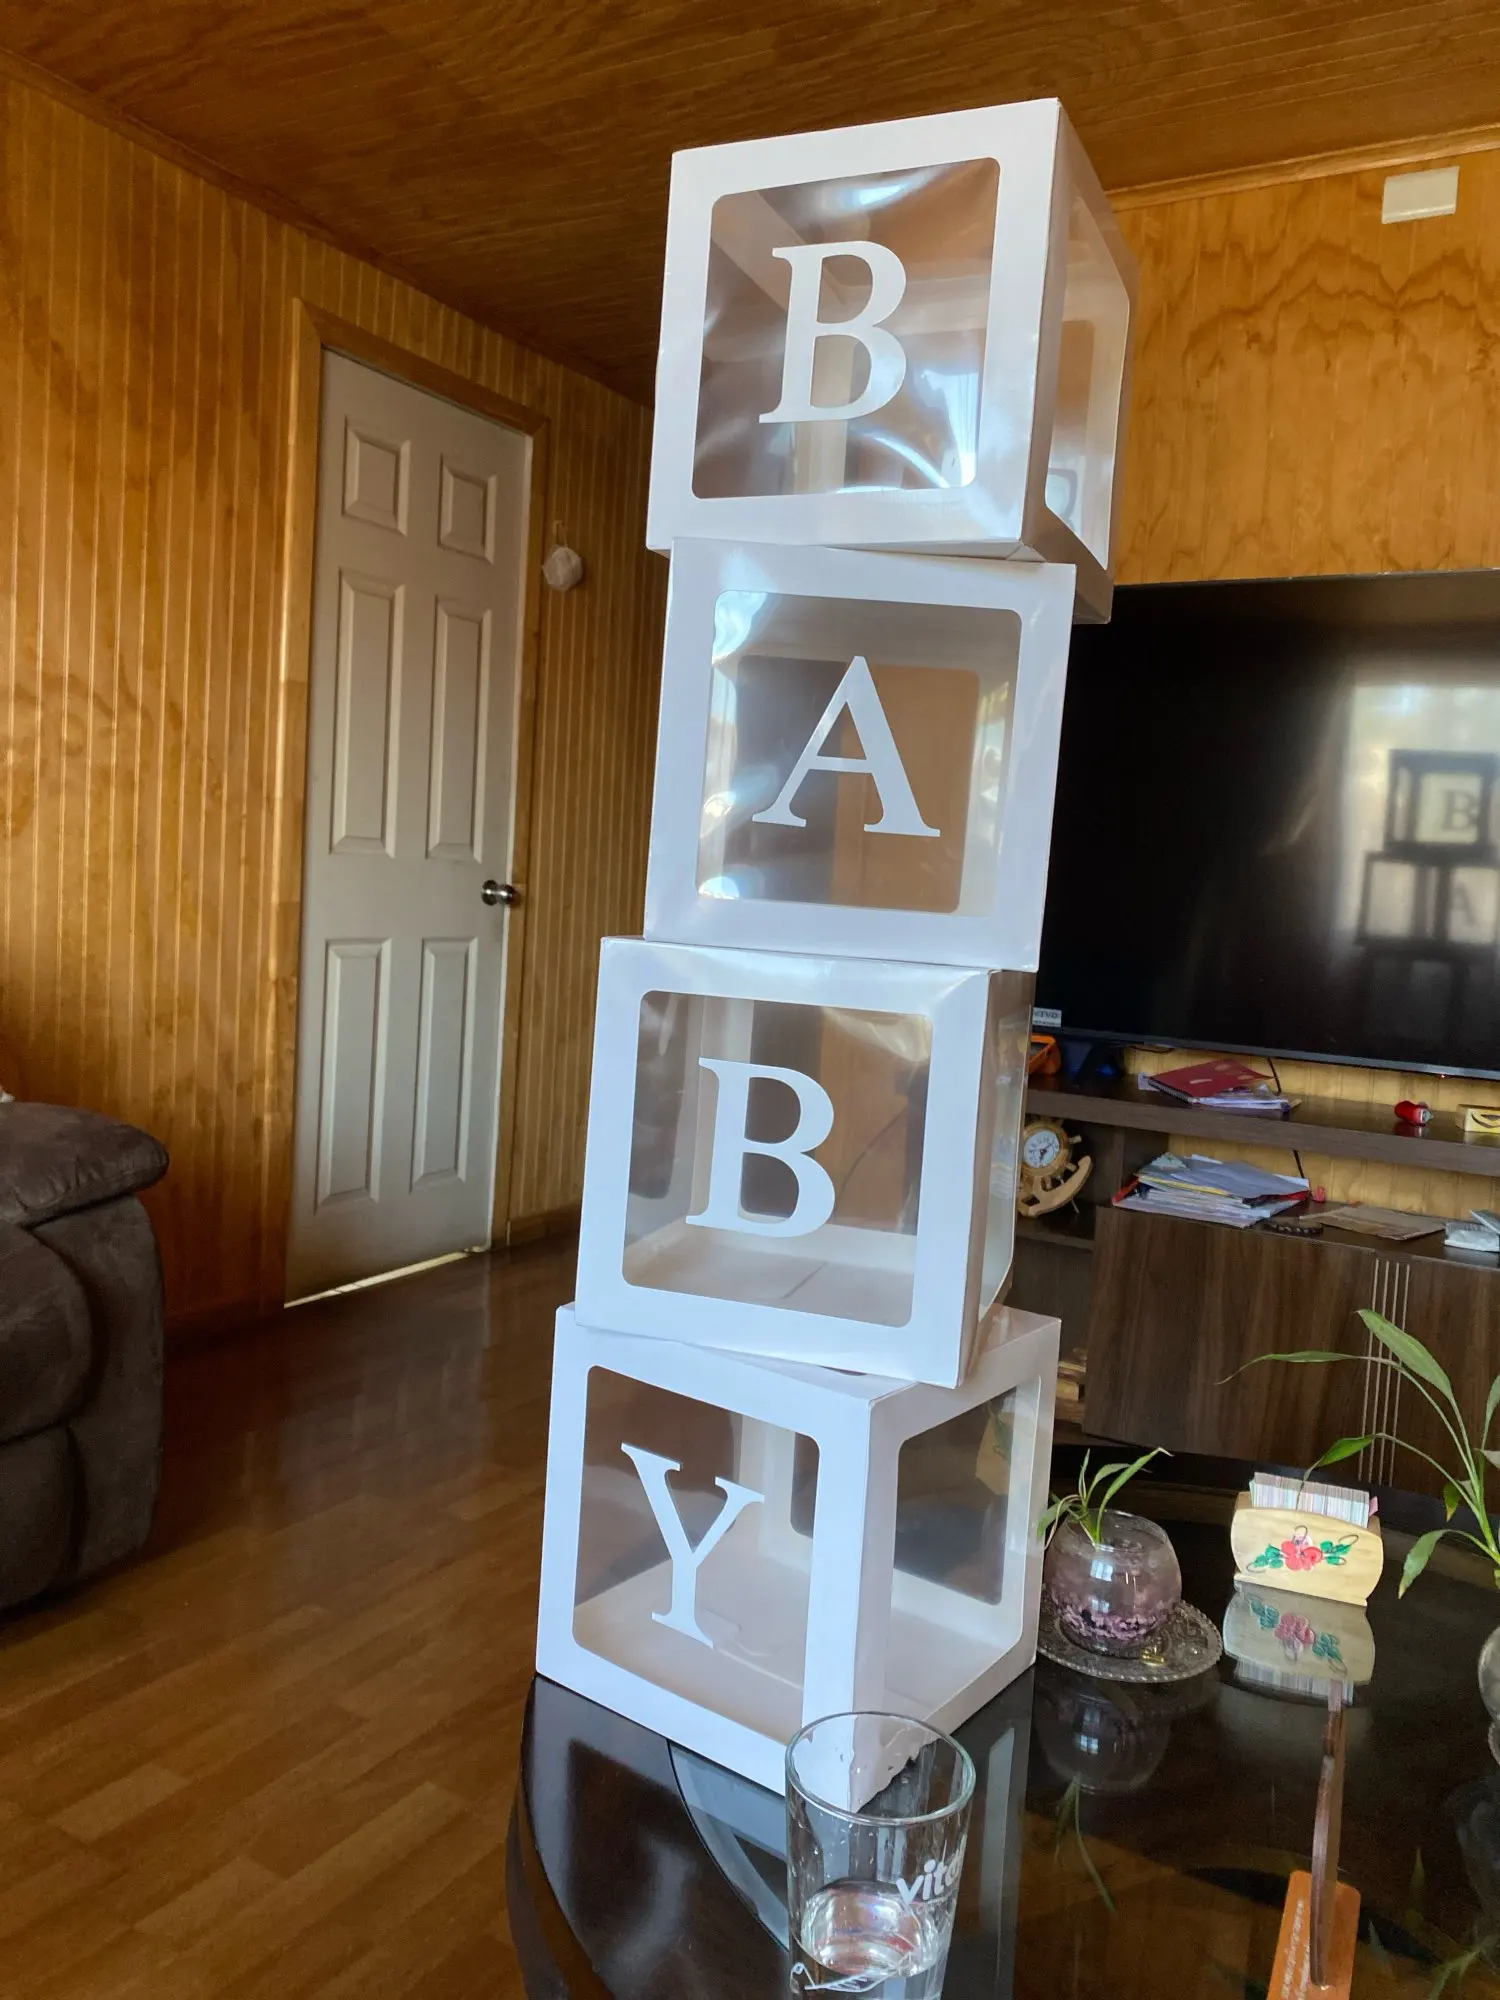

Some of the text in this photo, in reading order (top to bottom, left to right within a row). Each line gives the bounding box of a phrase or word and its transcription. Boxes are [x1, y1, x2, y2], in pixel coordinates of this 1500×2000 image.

[759, 240, 907, 424] B
[752, 655, 941, 838] A
[685, 1057, 836, 1238] B
[620, 1442, 765, 1650] Y
